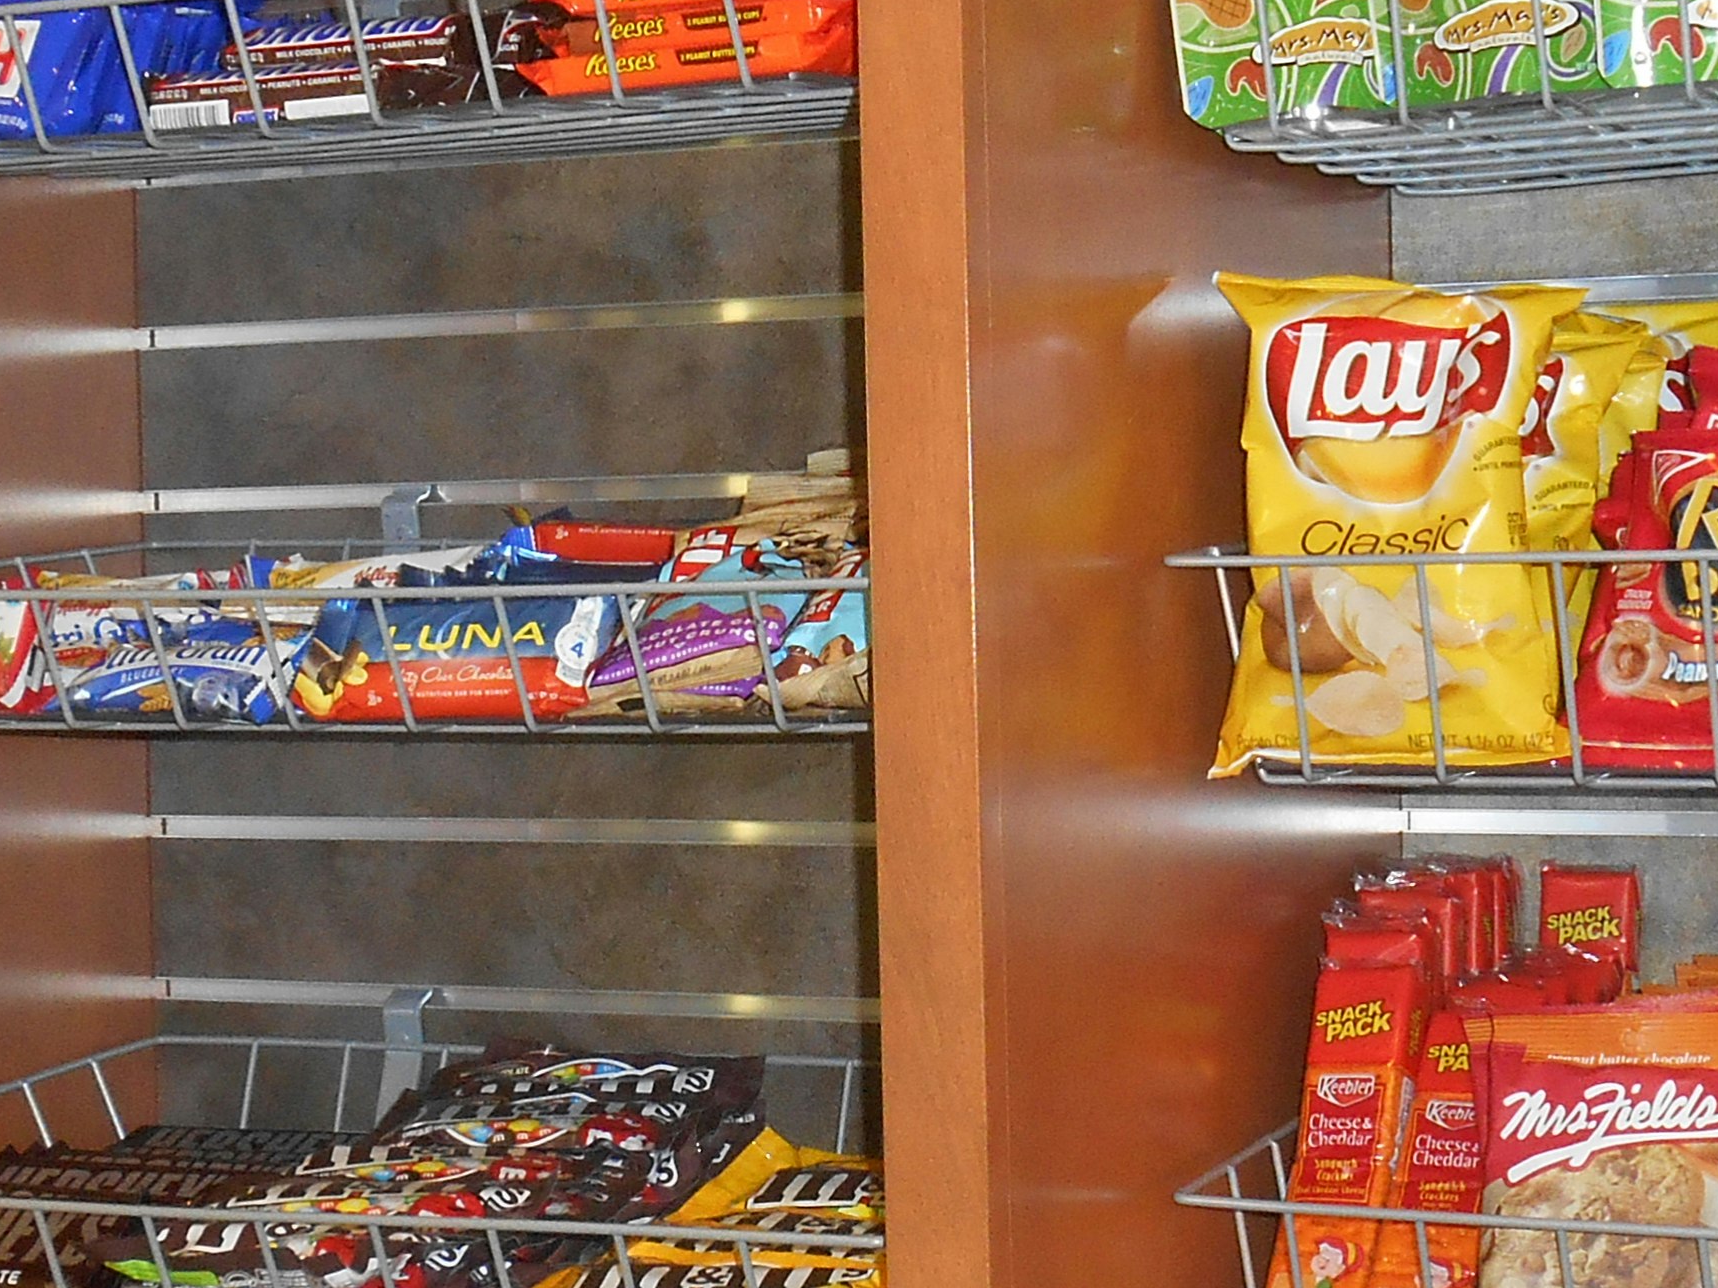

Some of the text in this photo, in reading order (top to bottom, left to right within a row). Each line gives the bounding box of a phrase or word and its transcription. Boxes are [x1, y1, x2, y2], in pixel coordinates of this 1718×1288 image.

[1447, 20, 1487, 46] Mrs.
[1286, 320, 1500, 444] Lay's
[1299, 513, 1470, 556] Classic
[383, 621, 546, 652] LUNA
[571, 641, 585, 659] 4
[1546, 905, 1611, 930] SNACK
[1557, 917, 1621, 944] PACK
[1315, 1000, 1383, 1029] SNACK
[1325, 1011, 1392, 1042] PACK
[1319, 1078, 1375, 1097] Keebler
[1308, 1113, 1361, 1133] Cheese
[1500, 1088, 1595, 1141] Mrs.
[1306, 1128, 1373, 1148] Cheddar
[1414, 1134, 1468, 1154] Cheese
[1412, 1148, 1479, 1169] Cheddar
